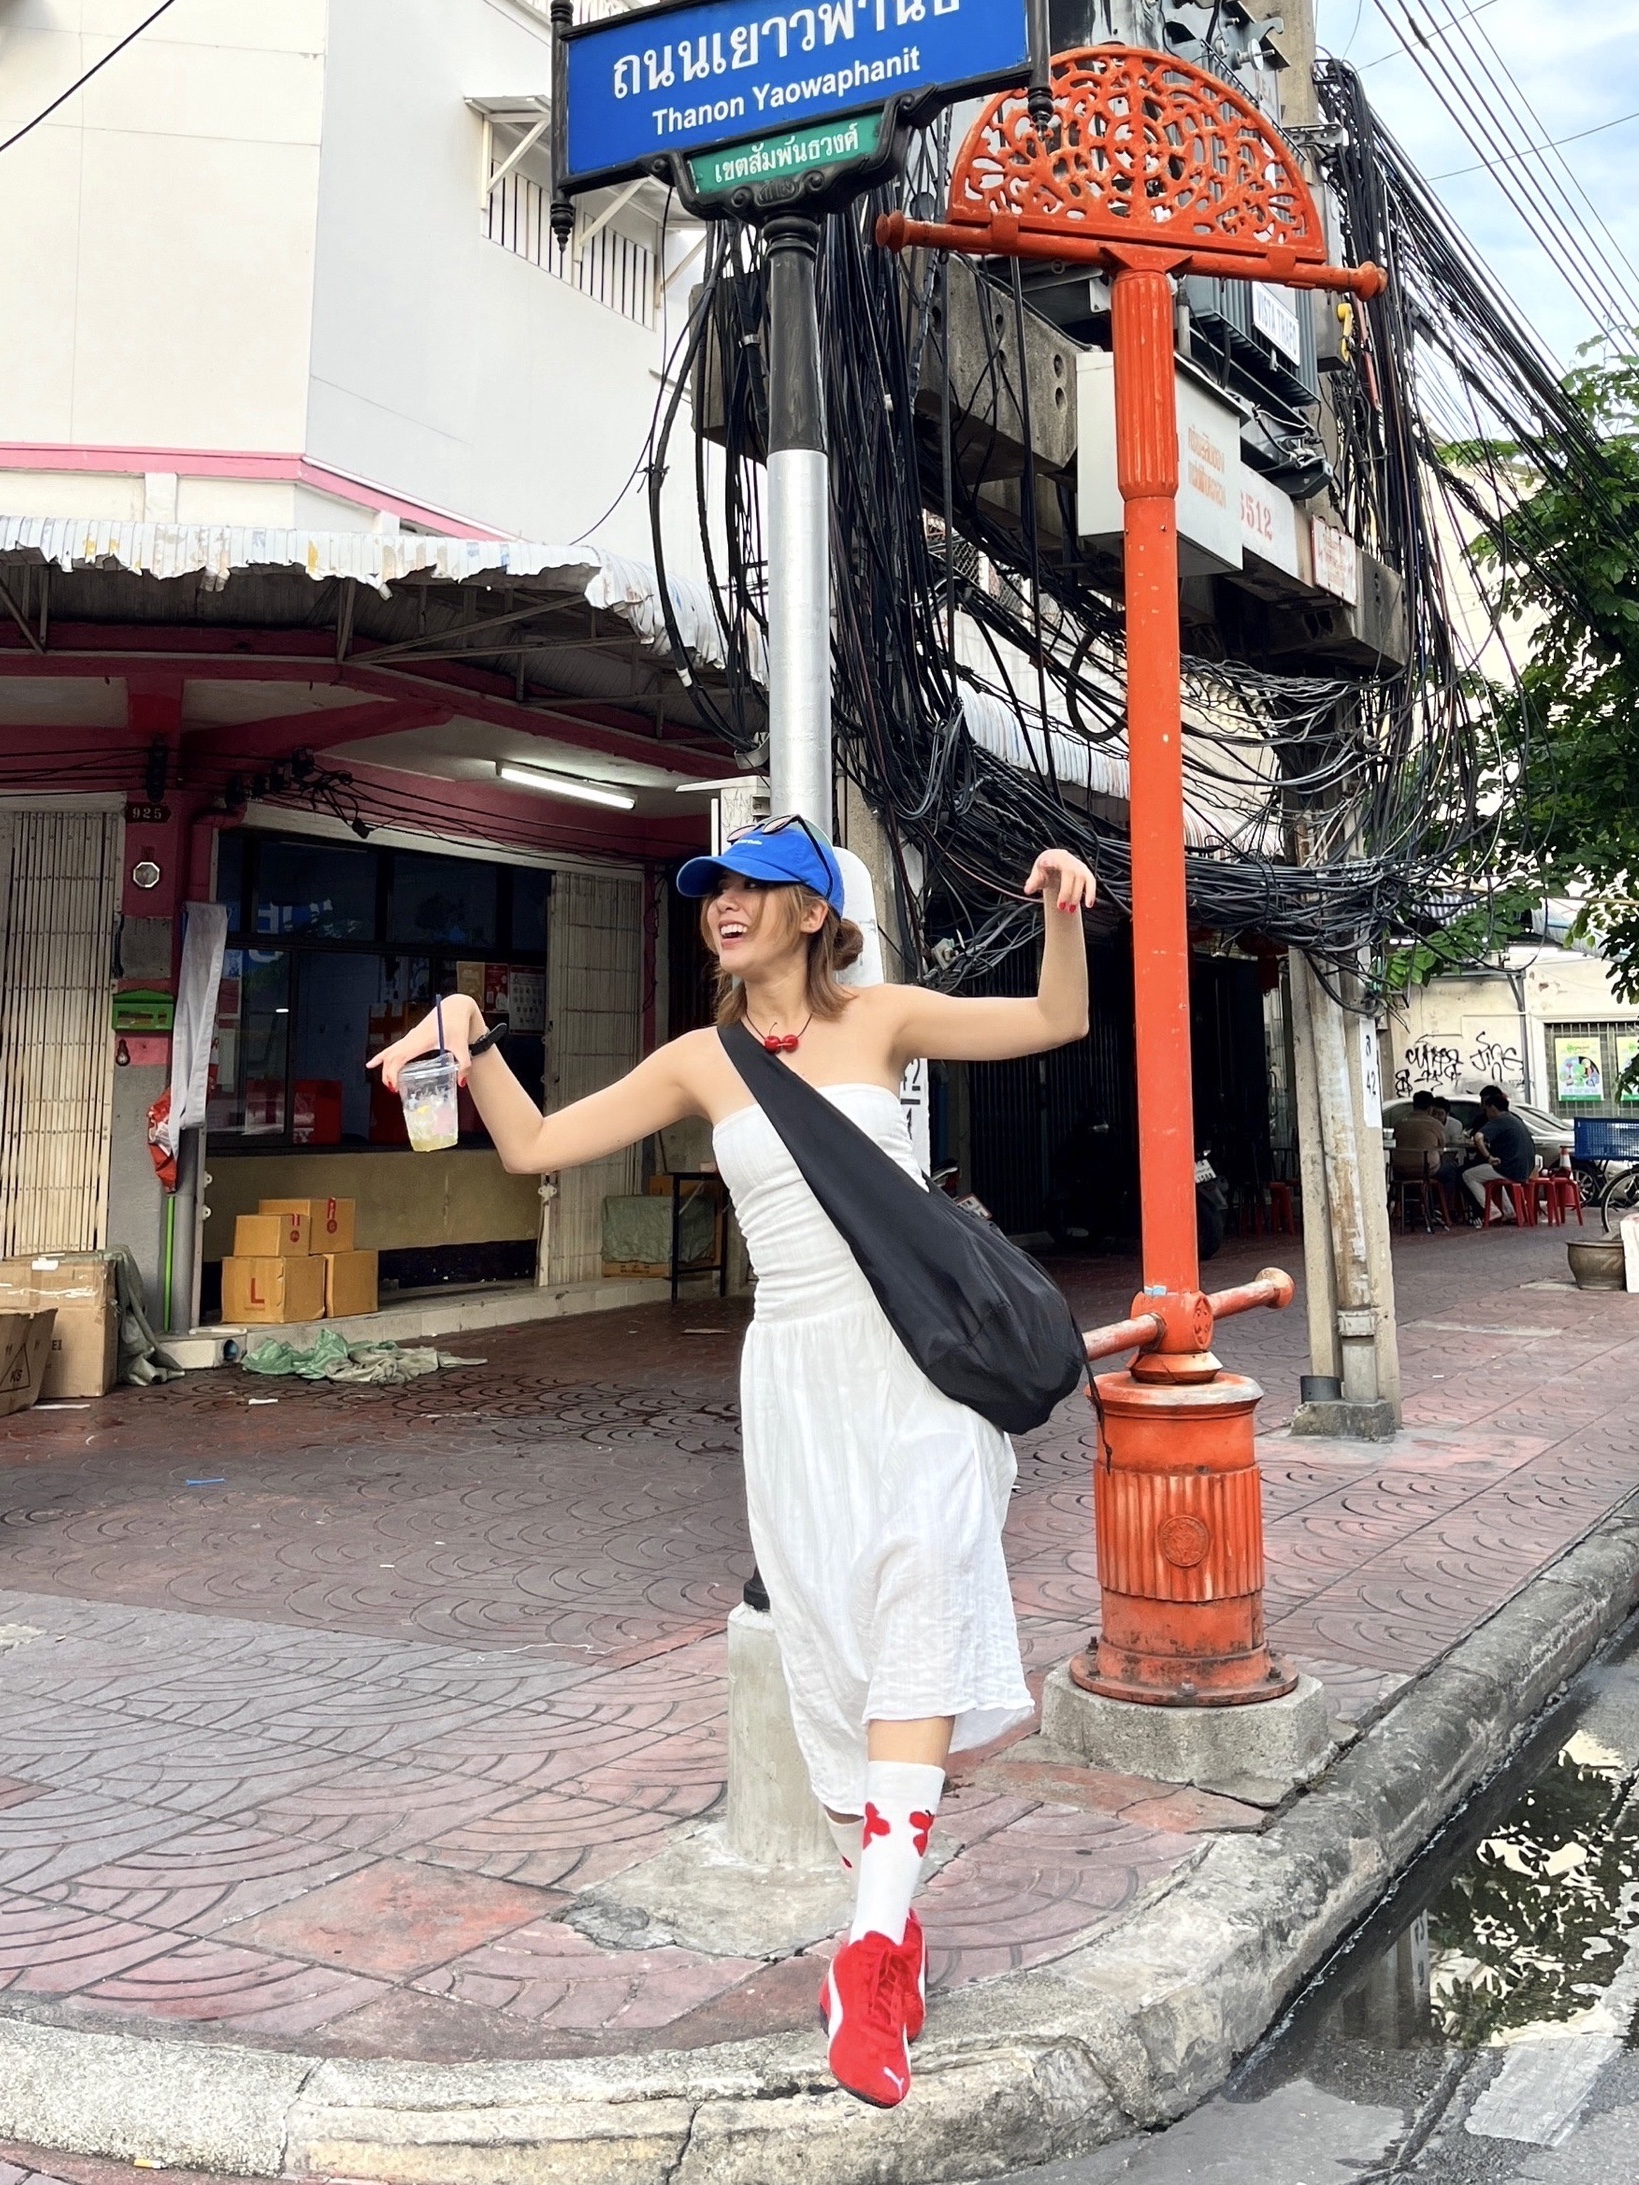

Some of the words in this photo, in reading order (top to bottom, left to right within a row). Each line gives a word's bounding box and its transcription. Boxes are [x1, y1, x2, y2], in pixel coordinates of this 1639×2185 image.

[652, 96, 745, 136] Thanon
[752, 45, 921, 111] Yaowaphanit
[714, 122, 860, 184] เขตสัมพันธวงศ์
[132, 807, 162, 820] 925
